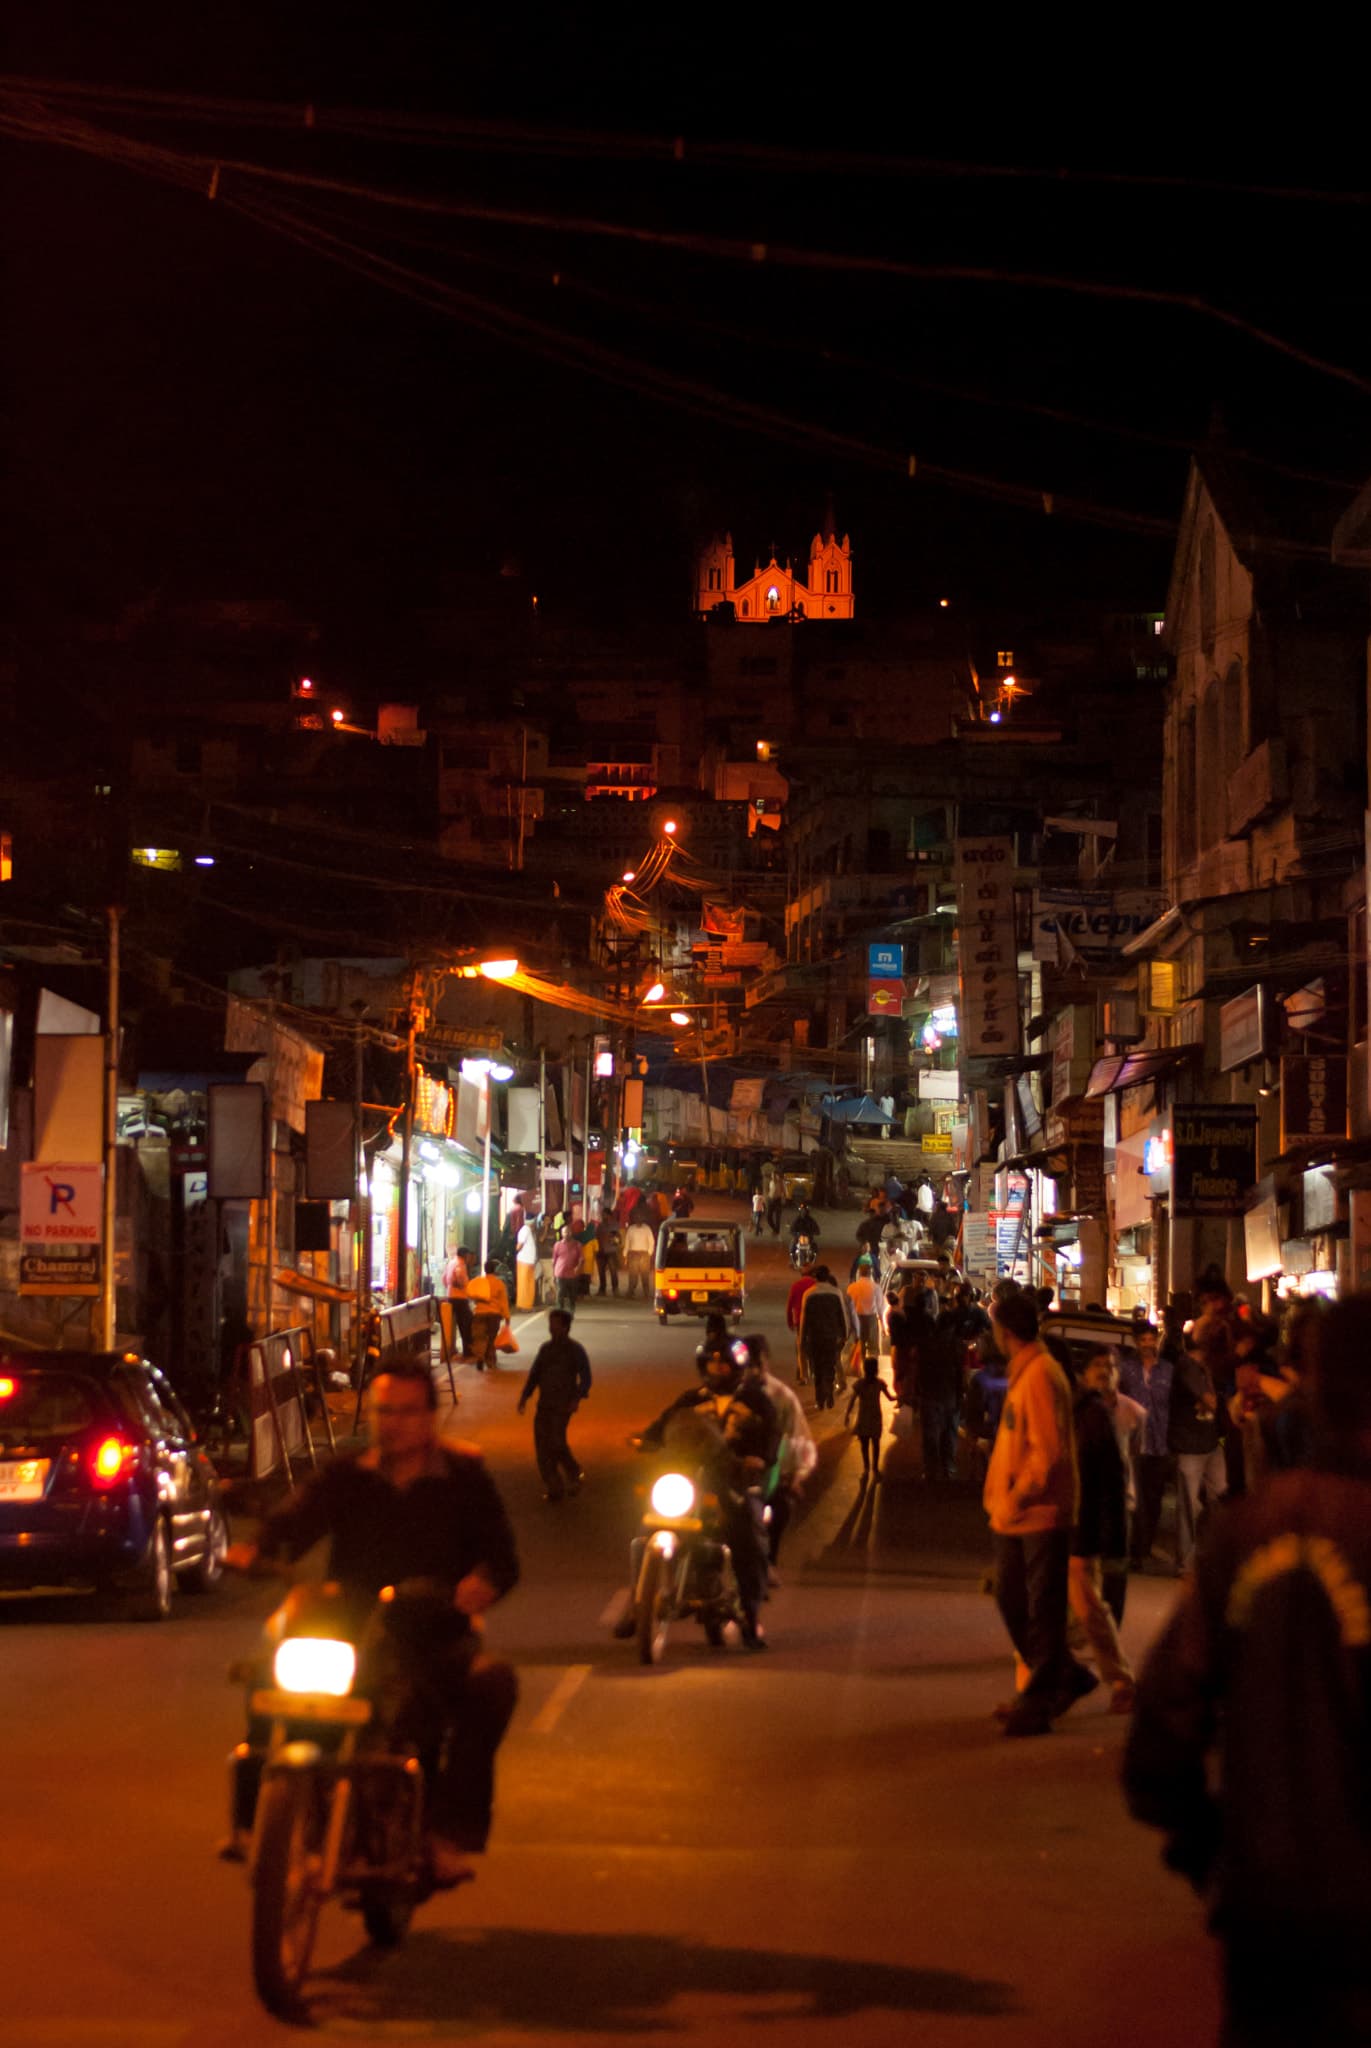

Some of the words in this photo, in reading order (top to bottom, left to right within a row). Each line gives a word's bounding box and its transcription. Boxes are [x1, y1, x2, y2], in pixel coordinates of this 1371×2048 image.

[24, 1225, 41, 1237] NO
[46, 1225, 96, 1238] PARKING
[24, 1257, 96, 1275] Chamraj
